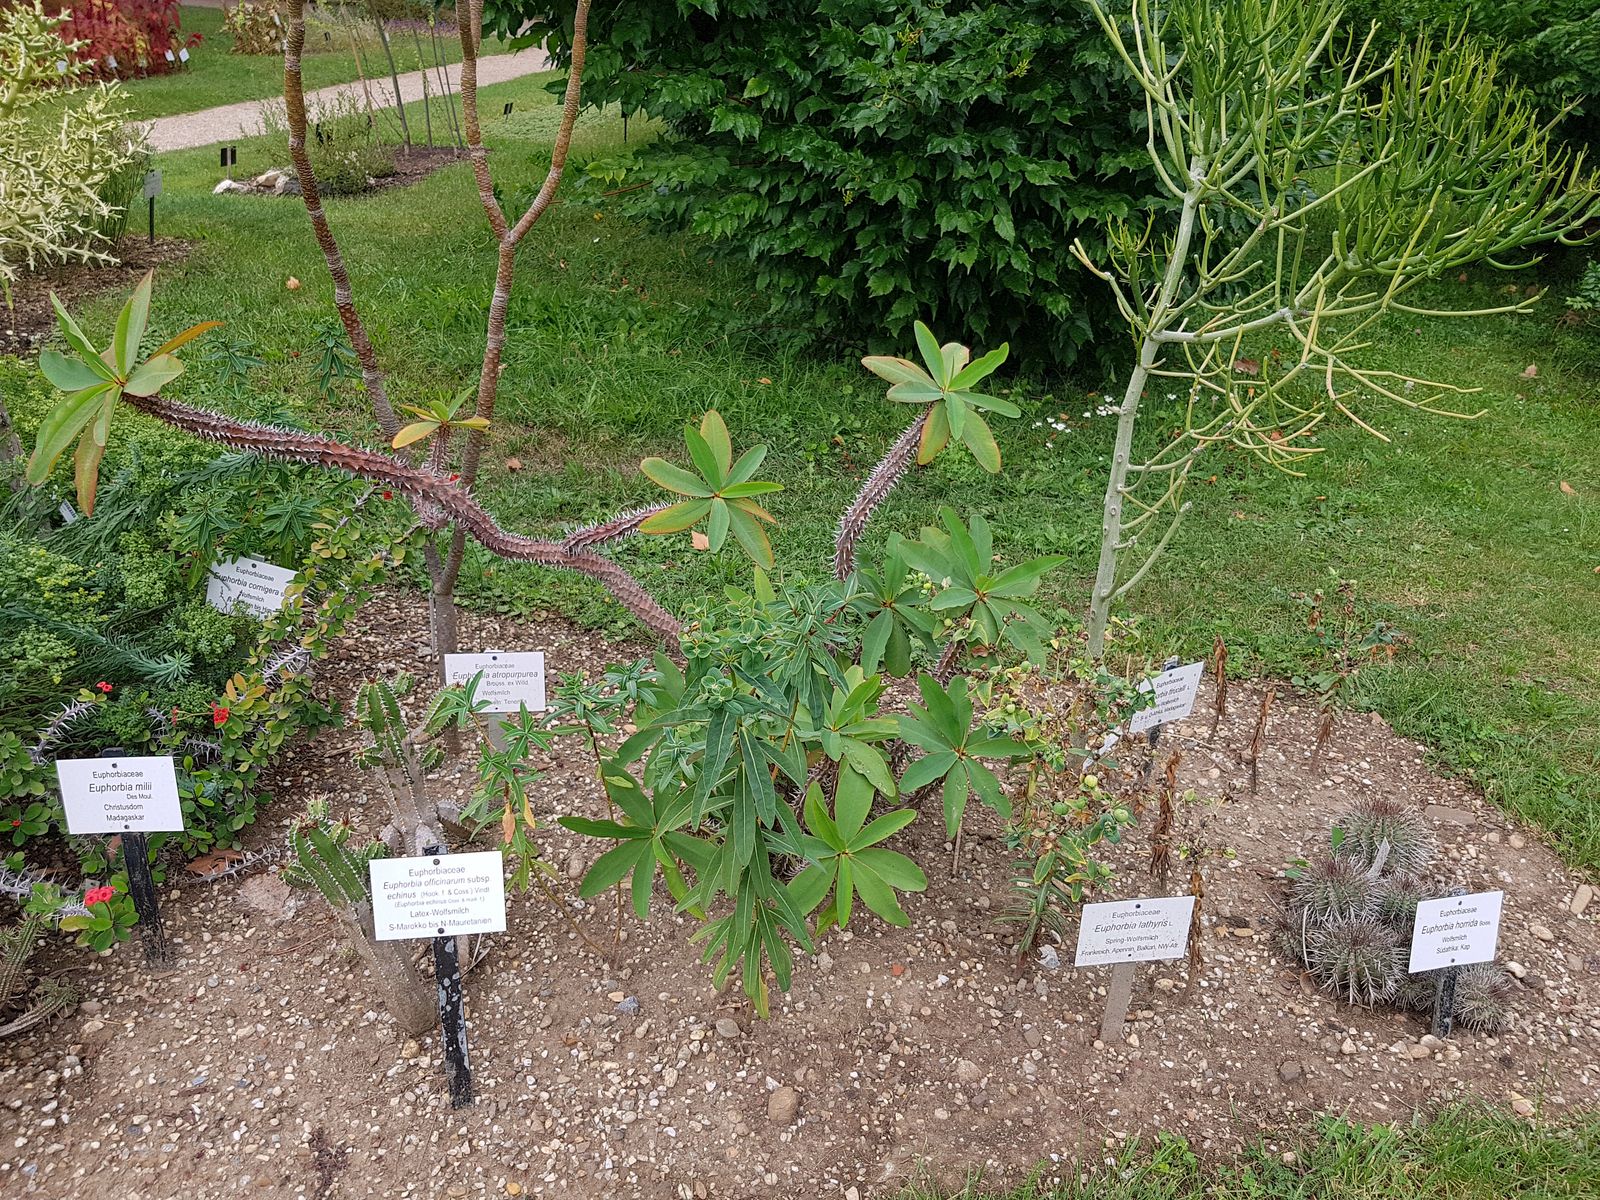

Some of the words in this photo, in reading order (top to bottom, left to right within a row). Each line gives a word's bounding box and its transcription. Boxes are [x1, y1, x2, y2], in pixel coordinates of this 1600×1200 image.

[236, 566, 275, 582] Euphorbiaceae
[214, 572, 248, 587] Euphorbia
[248, 582, 279, 596] cornigera
[492, 671, 538, 679] atropurpurea
[93, 771, 144, 779] Euphorbiaceae
[89, 783, 133, 794] Euphorbia
[135, 782, 152, 790] milii
[409, 867, 465, 878] Euphorbiaceae
[384, 880, 422, 890] Euphorbia
[424, 877, 465, 886] officinarum
[387, 892, 417, 900] echinus
[410, 907, 469, 918] Latex-Wolfsmilch
[1112, 909, 1160, 919] Euphorbiaceae
[1440, 907, 1477, 917] Euphorbiaceae
[389, 922, 427, 931] S-Marokko
[440, 917, 492, 927] N-Mauretanien
[1094, 922, 1137, 933] Euphorbia
[1422, 923, 1454, 934] Euphorbia
[1106, 935, 1159, 944] Spring-Wolfsmilch
